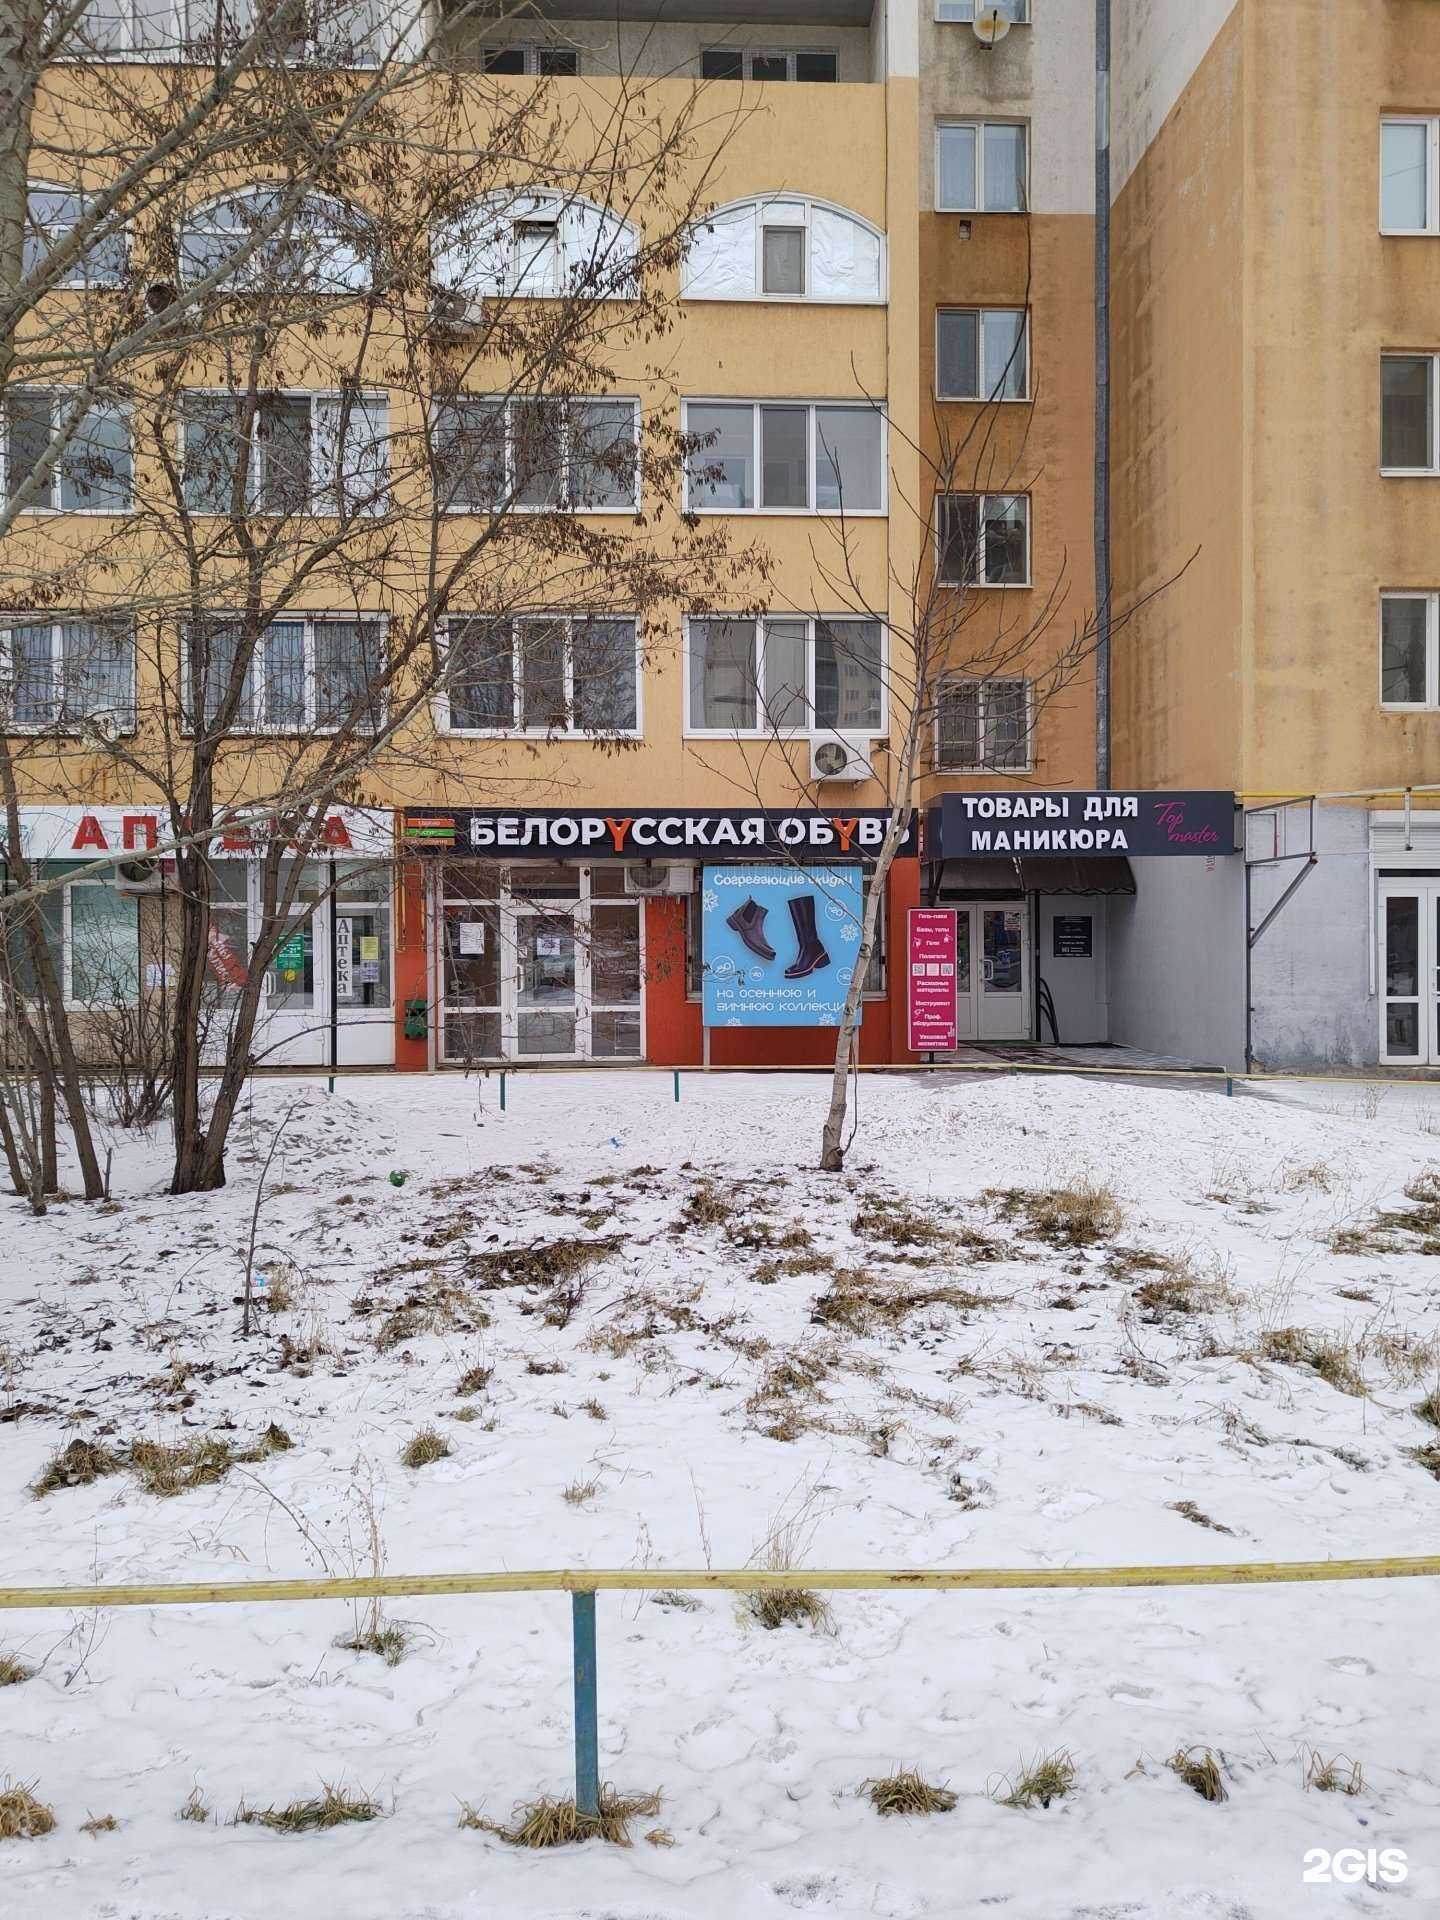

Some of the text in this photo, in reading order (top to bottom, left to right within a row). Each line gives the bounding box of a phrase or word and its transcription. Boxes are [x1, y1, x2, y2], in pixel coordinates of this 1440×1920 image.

[962, 797, 1138, 821] ТОВАРЫ ДЛЯ
[1153, 801, 1186, 832] Top
[971, 829, 1129, 851] МАНИКЮРА
[337, 919, 350, 994] Аптека
[716, 989, 816, 998] на осеннюю и
[716, 1002, 774, 1011] зимнюю
